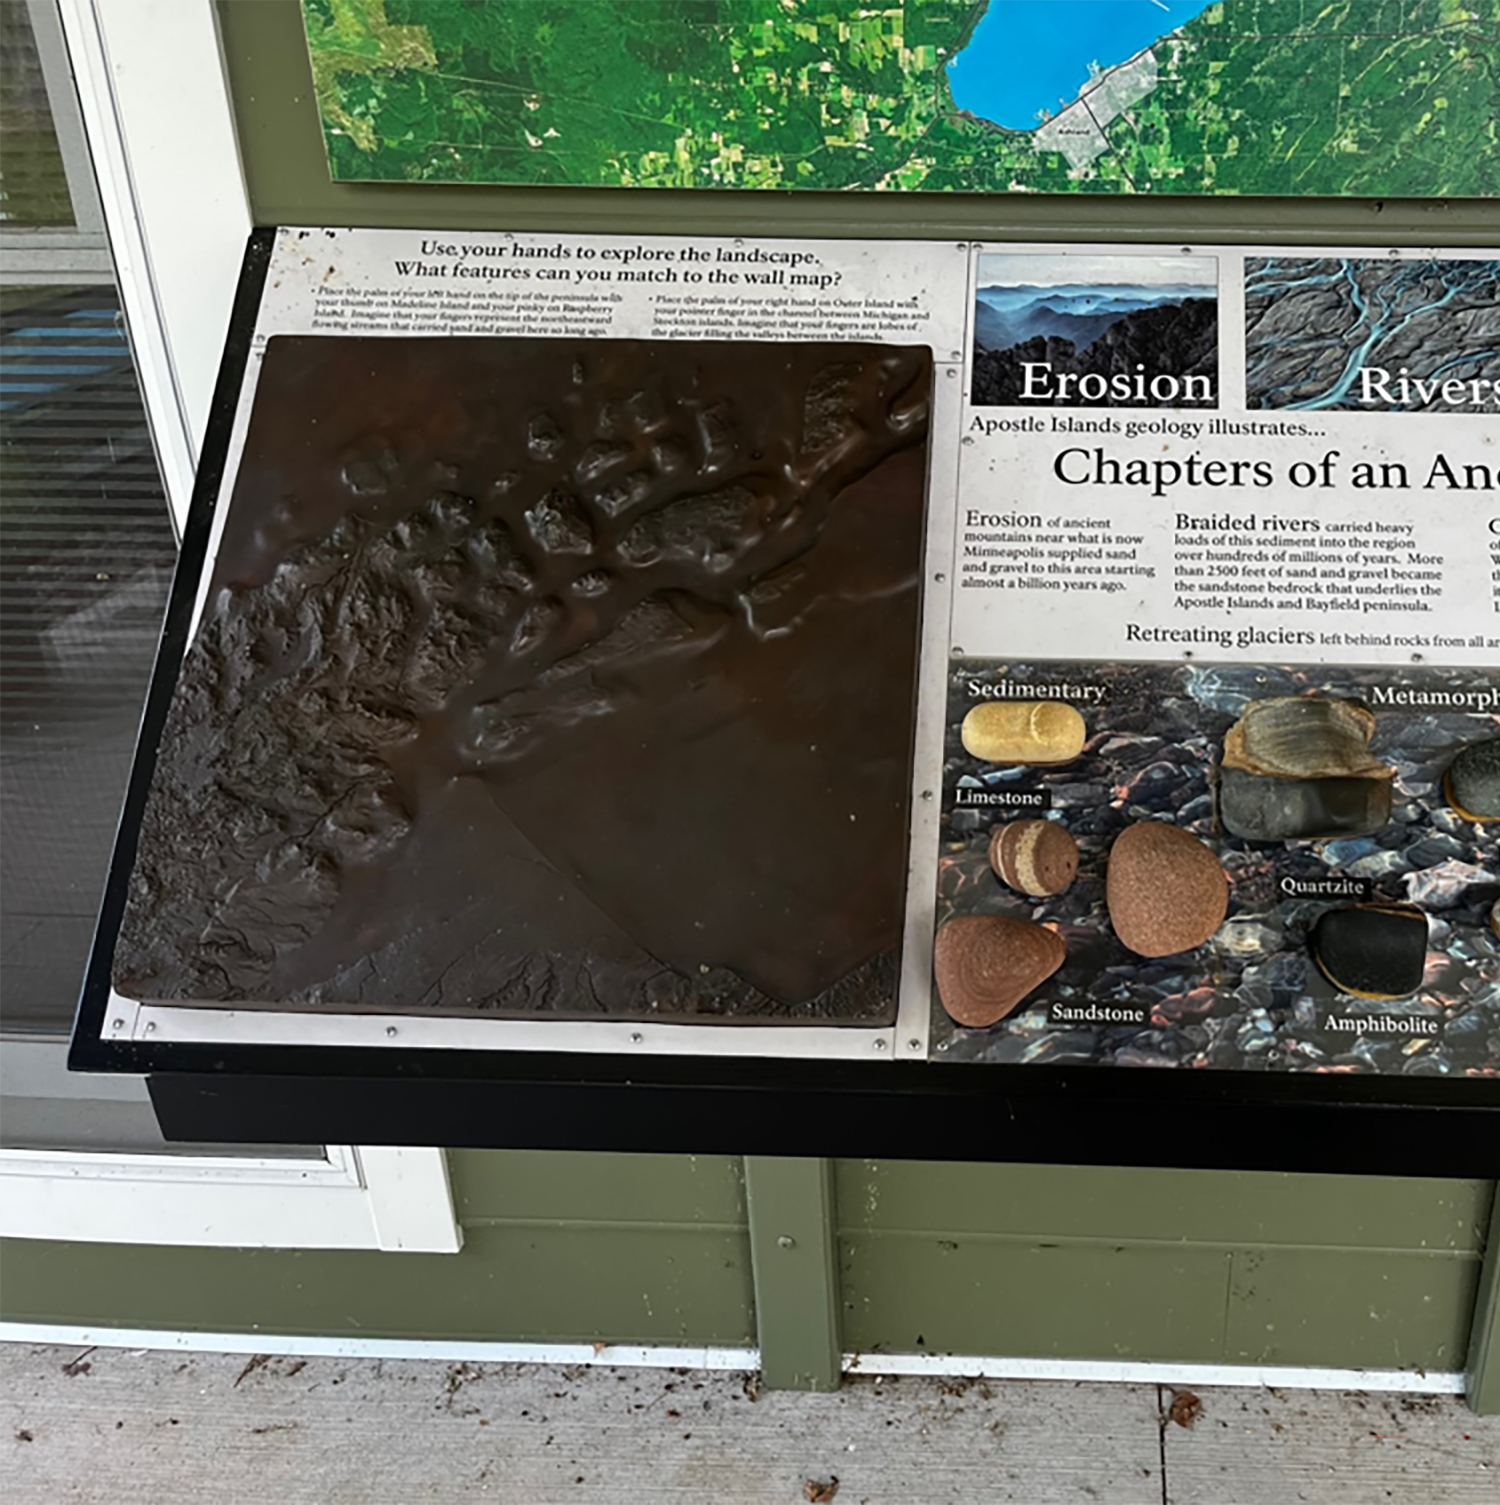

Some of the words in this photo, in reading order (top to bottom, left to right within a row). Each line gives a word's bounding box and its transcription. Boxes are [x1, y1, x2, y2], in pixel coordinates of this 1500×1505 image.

[421, 241, 458, 255] Use
[461, 246, 507, 259] your
[512, 243, 571, 258] hands
[576, 247, 595, 259] to
[600, 246, 674, 263] explore
[680, 247, 710, 261] the
[716, 248, 819, 267] landscape.
[395, 261, 446, 276] What
[452, 262, 530, 278] features
[536, 269, 570, 279] can
[576, 270, 611, 284] you
[617, 268, 677, 281] match
[683, 271, 702, 282] to
[708, 269, 739, 283] the
[744, 270, 784, 284] wall
[790, 272, 842, 289] map?
[390, 299, 437, 308] Madeline
[562, 304, 613, 316] Raspberry
[1018, 362, 1214, 401] Erosion
[969, 416, 1044, 435] Apostle
[1051, 417, 1121, 432] Islands
[1125, 419, 1203, 439] geology
[1209, 419, 1325, 435] illustrates...
[1053, 448, 1273, 495] Chapters
[1288, 451, 1340, 487] of
[1352, 463, 1411, 488] an
[966, 510, 1042, 527] Erosion
[1047, 517, 1061, 527] of
[1063, 518, 1110, 528] ancient
[1176, 514, 1255, 530] Braided
[1262, 515, 1320, 531] rivers
[1325, 522, 1372, 532] carried
[1375, 522, 1412, 535] heavy
[1174, 596, 1224, 609] Apostle
[1227, 597, 1274, 608] Islands
[1277, 598, 1302, 609] and
[1306, 598, 1360, 612] Bayfield
[1363, 600, 1432, 613] peninsula.
[1126, 625, 1233, 647] Retreating
[1236, 628, 1315, 648] glaciers
[1320, 633, 1341, 644] left
[1344, 633, 1391, 645] behind
[1394, 635, 1430, 646] rocks
[1433, 635, 1465, 646] from
[1468, 636, 1483, 647] all
[968, 680, 1105, 702] Sedimentary
[956, 789, 1043, 806] Limestone
[1281, 877, 1365, 896] Quartzite
[1052, 1003, 1144, 1021] Sandstone
[1324, 1014, 1438, 1036] Amphibolite
